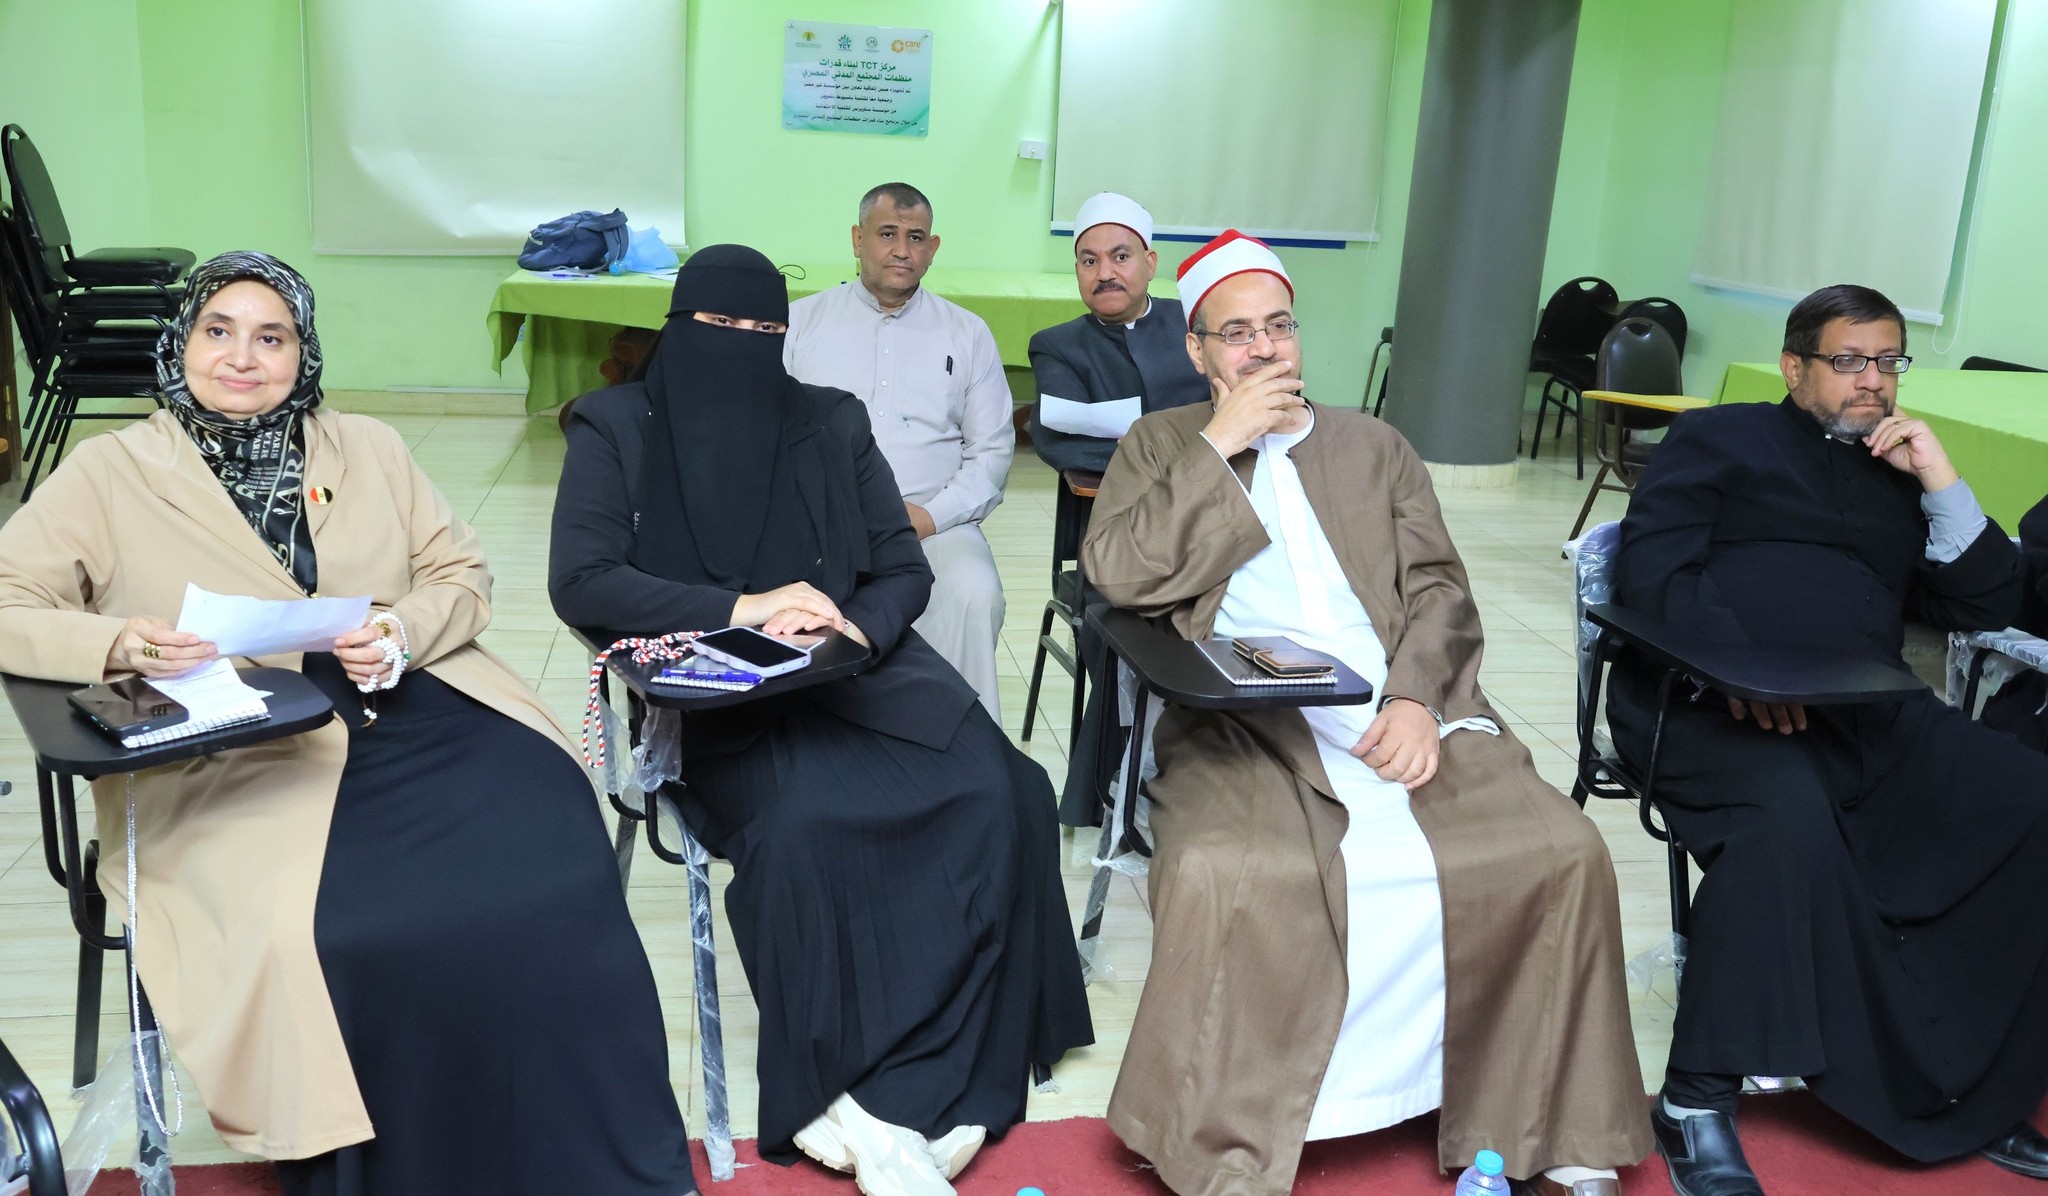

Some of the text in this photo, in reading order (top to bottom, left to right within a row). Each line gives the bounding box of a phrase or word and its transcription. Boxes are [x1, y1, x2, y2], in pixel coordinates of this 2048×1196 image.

[905, 40, 921, 48] care
[820, 58, 896, 72] مركز TCT لبناء قدرات
[802, 70, 912, 82] منظمات المجتمع المدني المصري
[270, 430, 282, 459] PARIS
